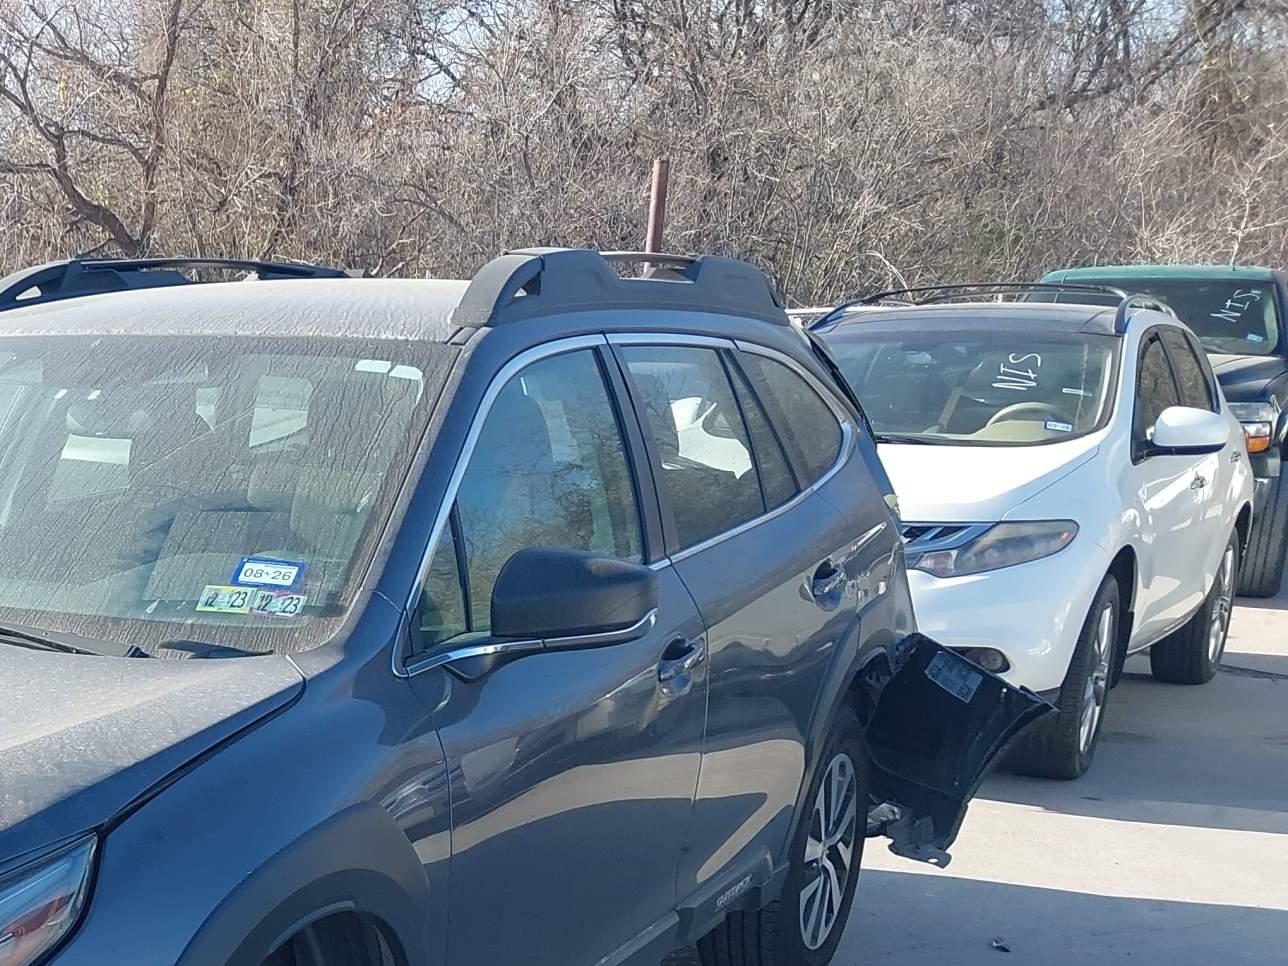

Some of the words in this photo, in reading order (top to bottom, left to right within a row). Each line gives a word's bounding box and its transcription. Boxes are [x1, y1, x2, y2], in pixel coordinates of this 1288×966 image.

[230, 591, 248, 608] 23
[257, 594, 273, 611] 12
[282, 597, 301, 614] 23
